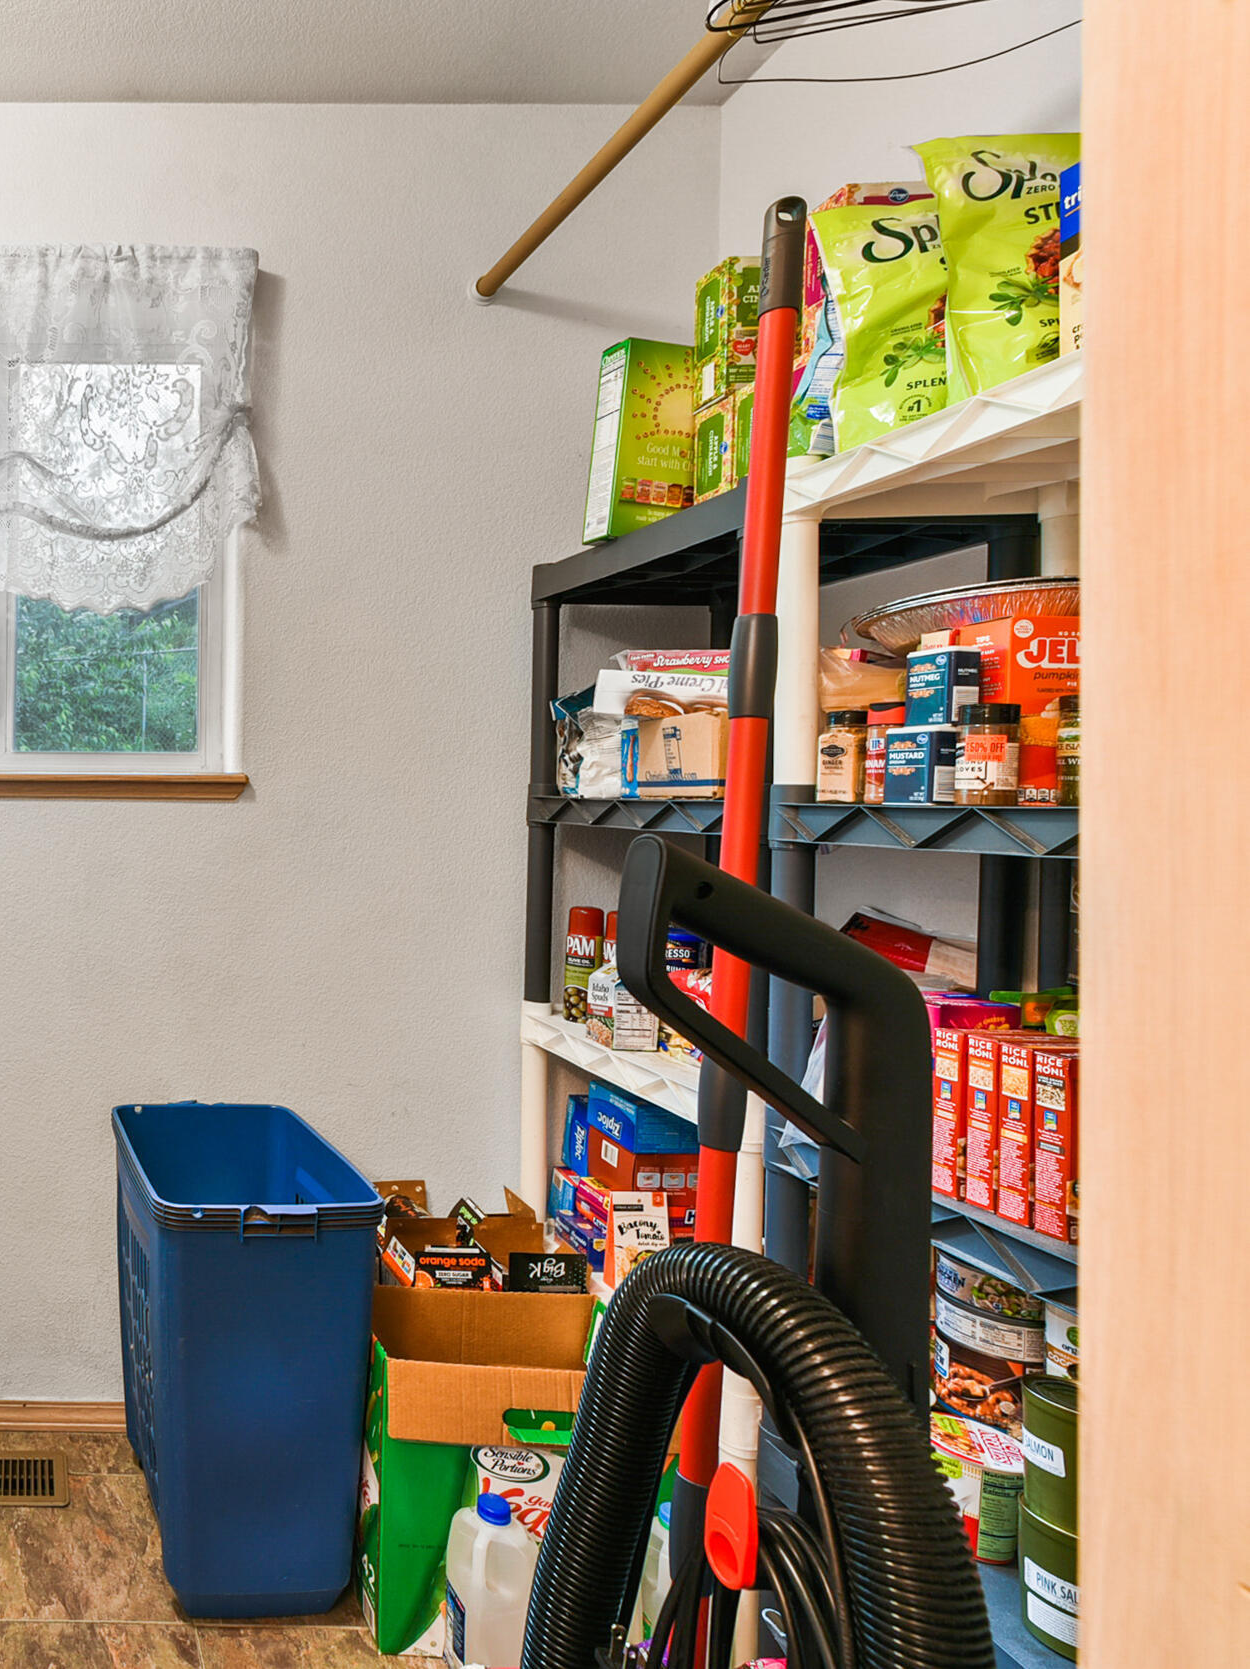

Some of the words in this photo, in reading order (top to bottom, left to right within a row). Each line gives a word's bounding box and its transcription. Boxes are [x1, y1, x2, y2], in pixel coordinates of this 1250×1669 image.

[1026, 184, 1056, 195] ZERO
[906, 377, 947, 391] SPLEN
[646, 442, 670, 455] Good
[637, 456, 657, 468] start
[660, 458, 680, 470] with
[1016, 637, 1080, 668] JEL
[653, 653, 713, 668] Strawberry
[631, 673, 664, 689] Pies
[666, 676, 717, 693] Creme
[909, 673, 941, 683] NUTMEG
[990, 742, 1005, 753] OFF
[1065, 742, 1081, 751] ISLA
[889, 751, 924, 760] MUSTARD
[566, 935, 595, 957] PAM
[592, 983, 610, 994] Idaho
[591, 991, 609, 1003] Spuds
[936, 1030, 958, 1042] RICE
[969, 1038, 992, 1050] RICE
[1002, 1045, 1027, 1058] RICE
[1036, 1054, 1063, 1067] RICE
[597, 1111, 622, 1139] Ziploc
[574, 1125, 587, 1161] Ziploc
[617, 1219, 659, 1236] Bacony
[636, 1229, 666, 1241] Tomato
[419, 1256, 457, 1268] orange
[458, 1256, 486, 1267] soda
[542, 1257, 566, 1278] Big
[529, 1262, 542, 1278] K
[484, 1447, 534, 1463] Sensible
[1025, 1434, 1055, 1463] SALMON
[491, 1458, 538, 1476] Portions
[1036, 1572, 1057, 1597] PINK
[1060, 1585, 1081, 1606] SAL
